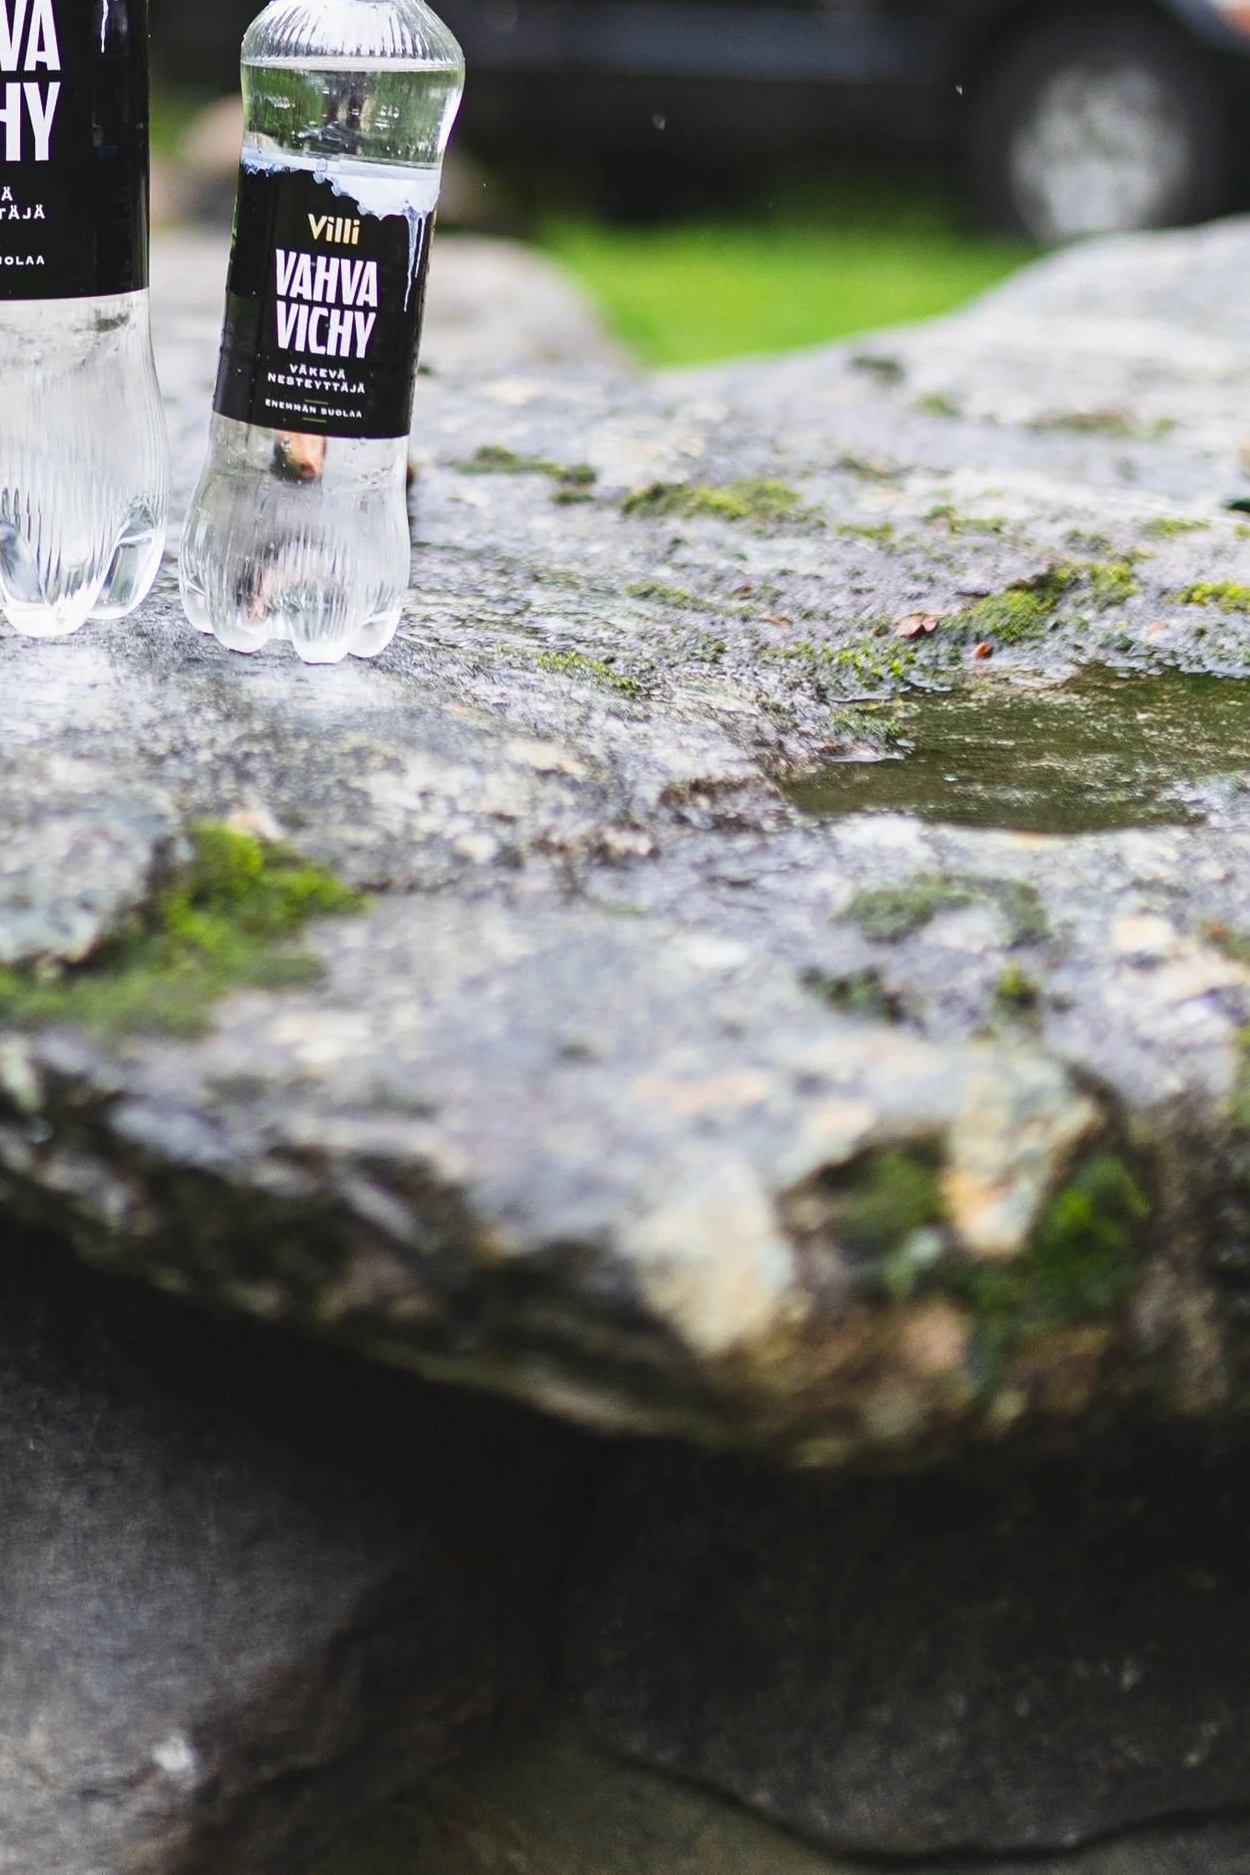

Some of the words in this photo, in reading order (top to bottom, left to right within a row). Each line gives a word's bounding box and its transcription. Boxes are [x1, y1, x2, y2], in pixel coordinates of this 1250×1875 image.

[308, 213, 360, 245] Villi
[275, 248, 378, 307] VAHVA
[276, 300, 376, 359] VICHY
[267, 372, 366, 394] NESTEYTTÄJÄ
[289, 363, 346, 380] VÄKEVÄ
[265, 398, 317, 414] ENEMMÄN
[320, 407, 362, 418] SUOLAA
